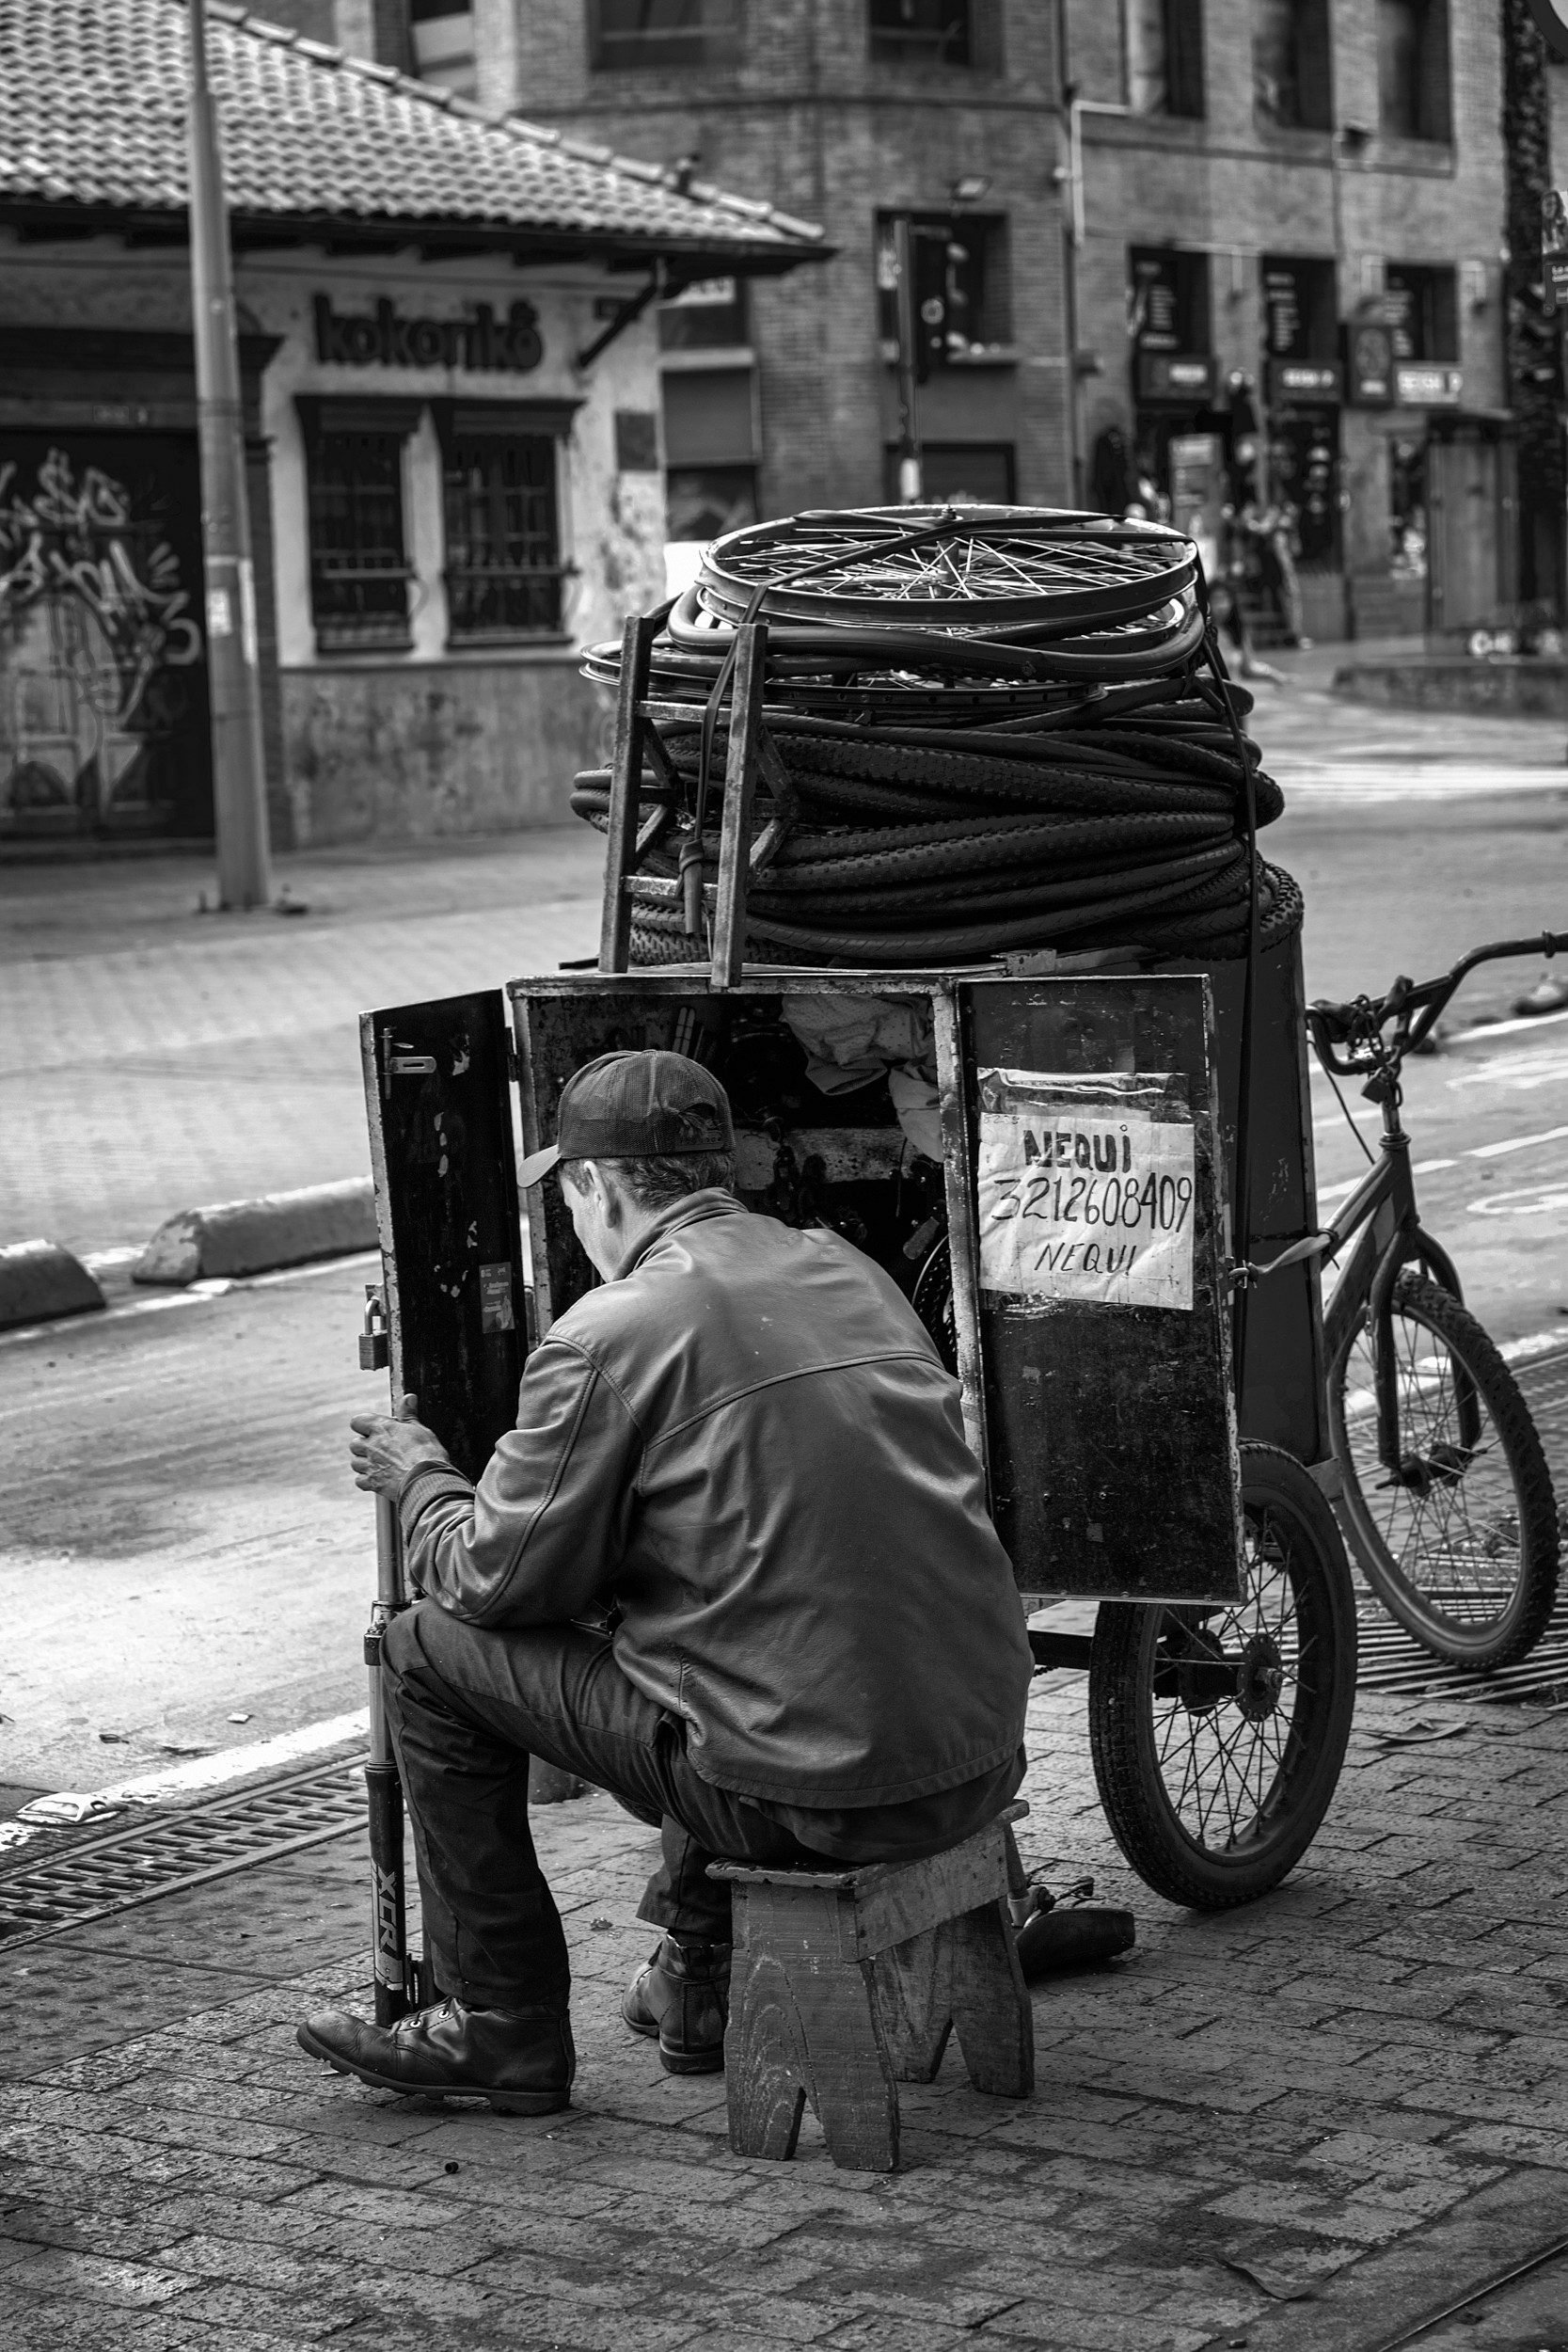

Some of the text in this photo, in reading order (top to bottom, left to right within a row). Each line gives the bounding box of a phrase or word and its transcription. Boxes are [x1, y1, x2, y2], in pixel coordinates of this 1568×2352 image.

[991, 1172, 1193, 1233] 3212608409
[1034, 1242, 1137, 1277] NEQUI
[377, 1865, 398, 1953] XCR
